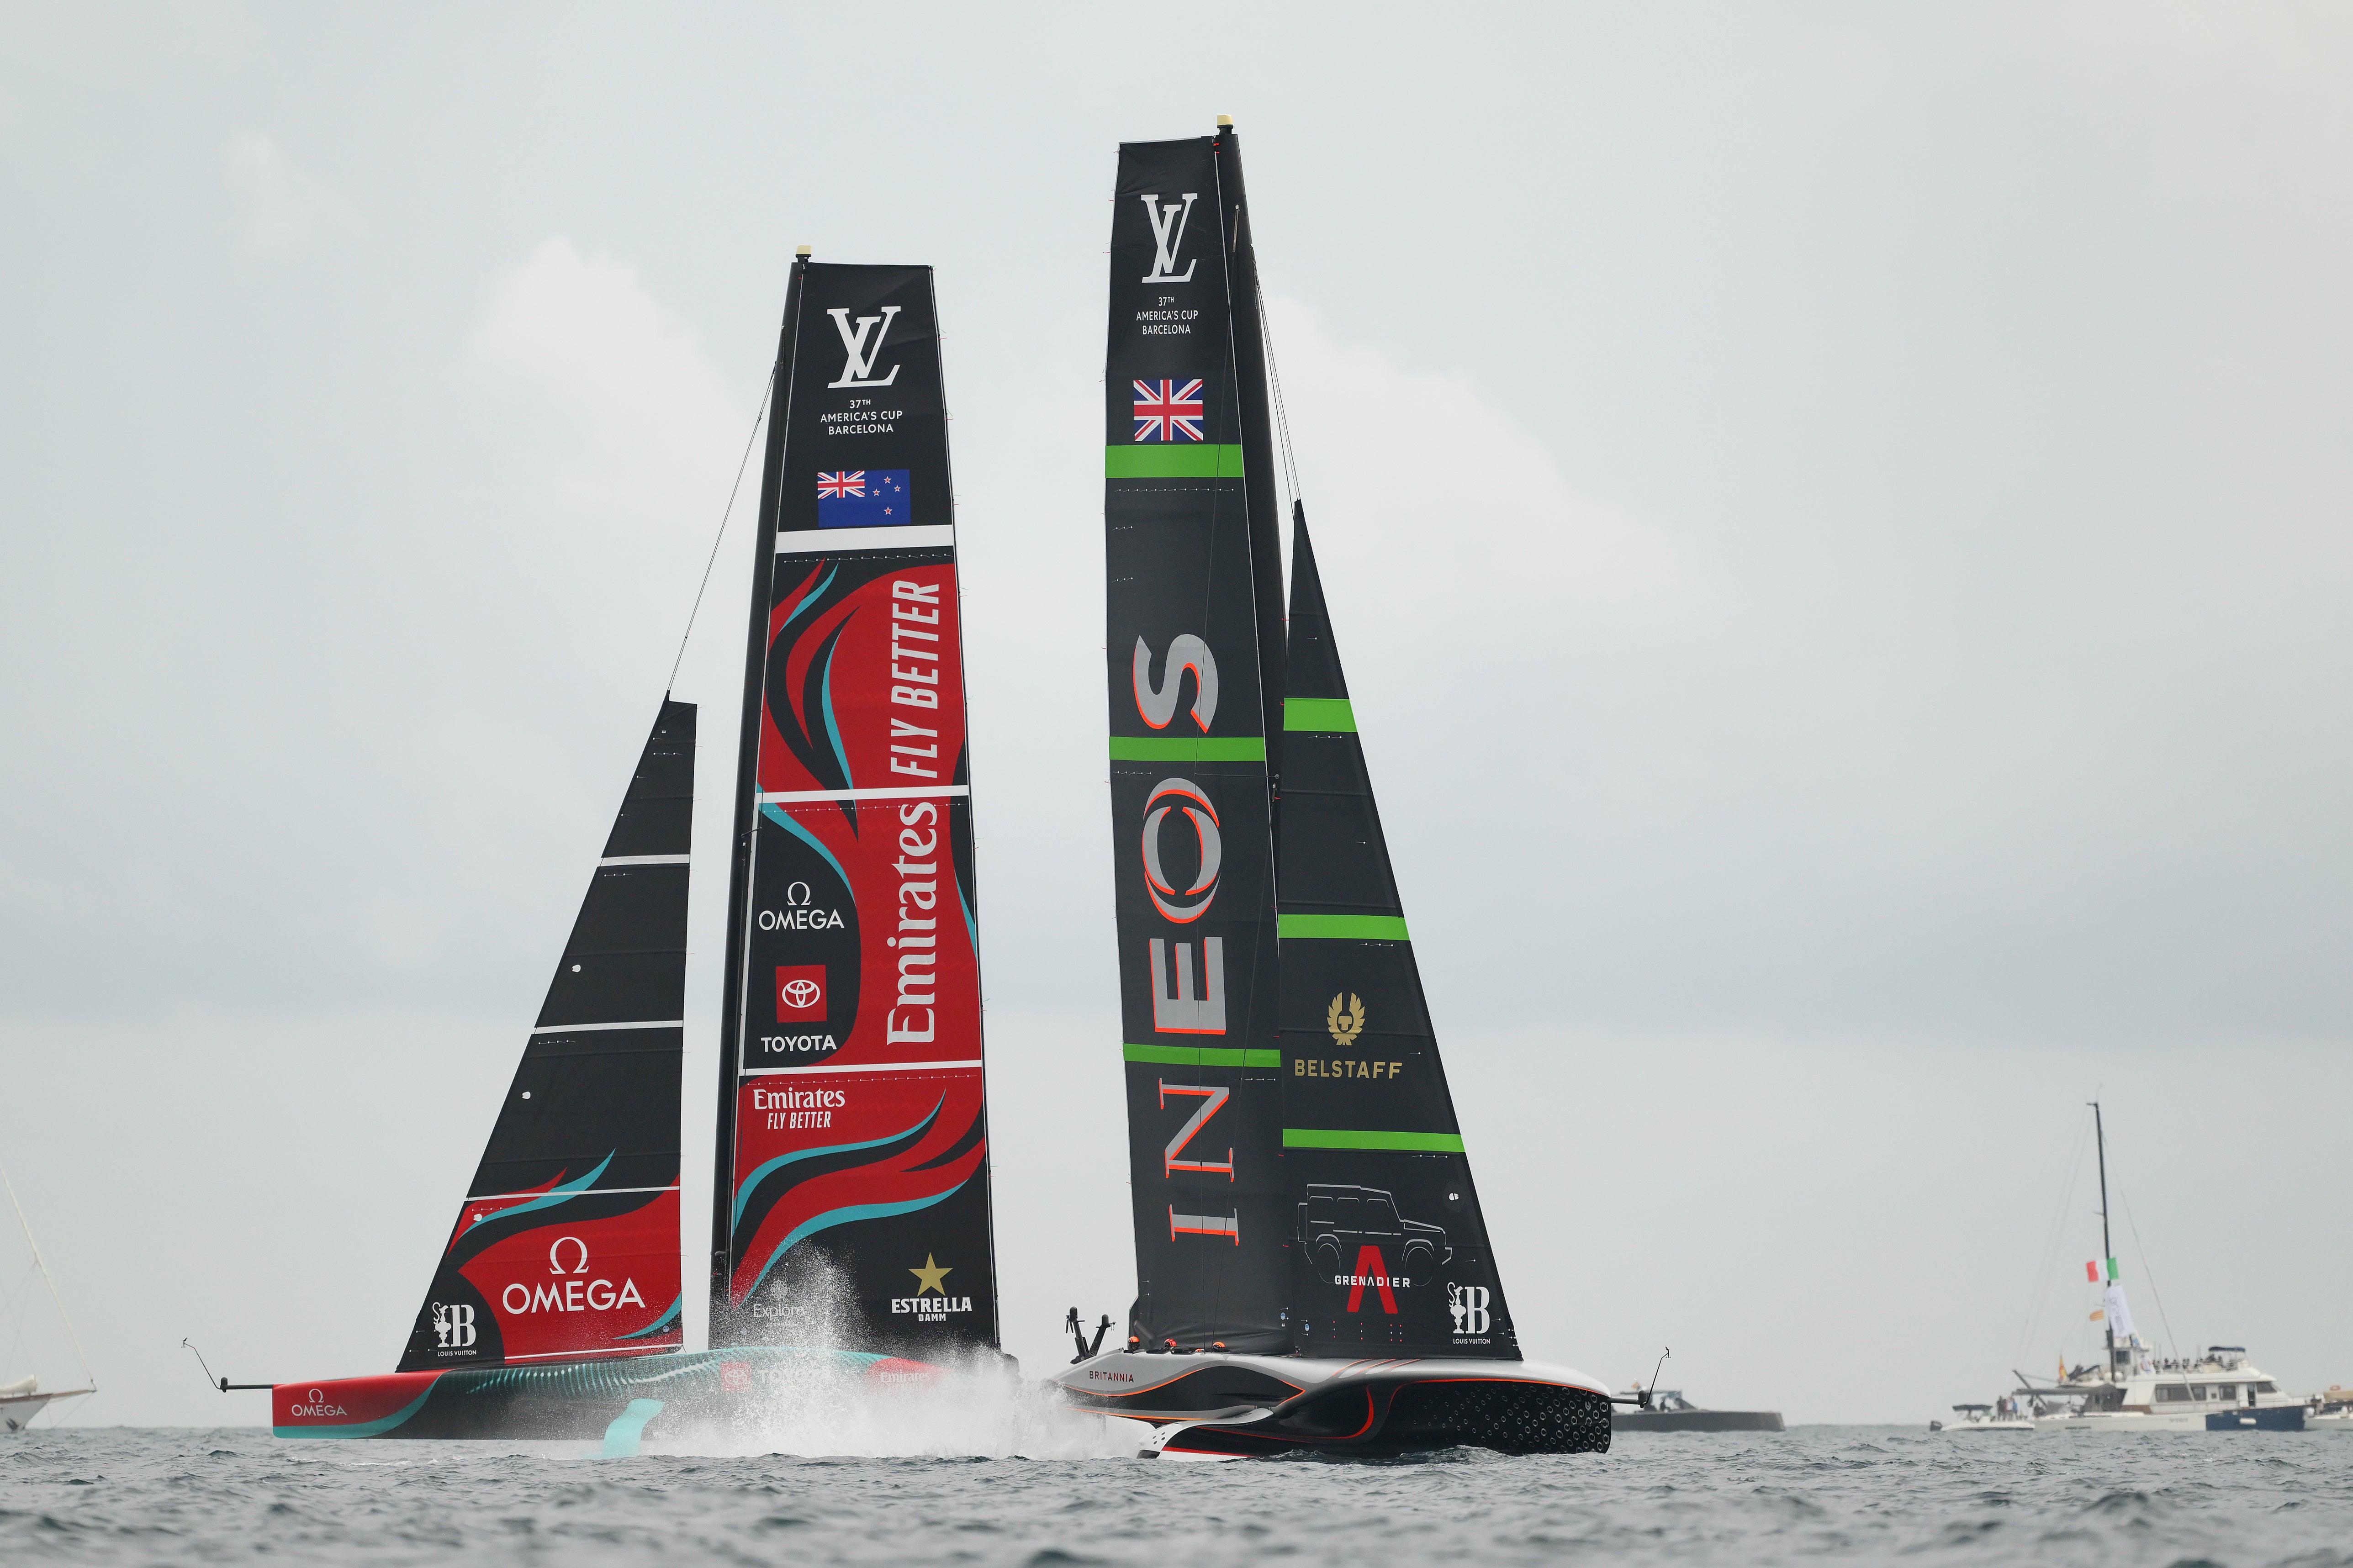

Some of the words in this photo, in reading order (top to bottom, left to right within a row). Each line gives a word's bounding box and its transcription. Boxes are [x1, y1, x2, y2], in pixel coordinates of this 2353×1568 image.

[1159, 297, 1174, 306] 37TH
[1181, 310, 1198, 320] CUP
[1143, 325, 1190, 334] BARCELONA
[850, 399, 870, 408] 37TH
[881, 411, 902, 420] CUP
[829, 424, 893, 435] BARCELONA
[891, 581, 939, 709] BETTER
[891, 718, 937, 778] FLY
[759, 909, 844, 930] OMEGA
[887, 802, 937, 1045] Emirates
[1133, 634, 1239, 1246] INEOS
[761, 1035, 837, 1052] TOYOTA
[1295, 1059, 1402, 1079] BELSTAFF
[753, 1087, 845, 1109] Emirates
[767, 1113, 786, 1129] FLY
[790, 1111, 831, 1129] BETTER
[1335, 1275, 1410, 1288] GRENADIER
[502, 1278, 645, 1314] OMEGA
[753, 1303, 805, 1321] Explora
[891, 1297, 972, 1313] ESTRELLA
[880, 1372, 930, 1383] Emirates
[1089, 1371, 1134, 1383] BRITANNIA
[291, 1404, 347, 1416] OMEGA
